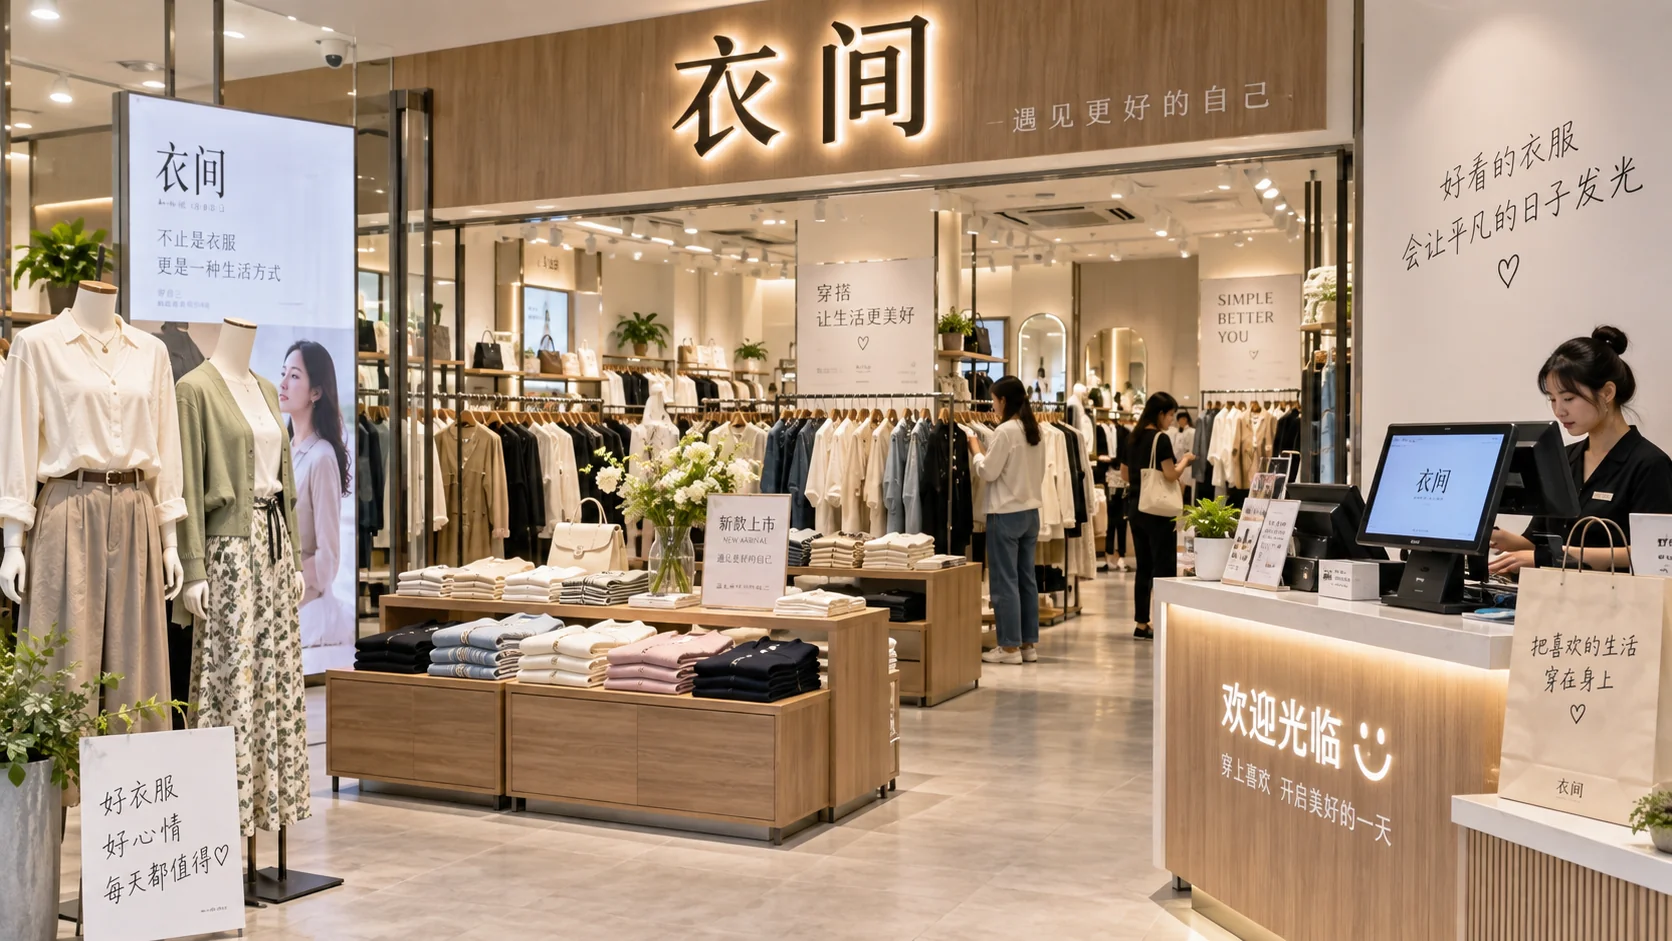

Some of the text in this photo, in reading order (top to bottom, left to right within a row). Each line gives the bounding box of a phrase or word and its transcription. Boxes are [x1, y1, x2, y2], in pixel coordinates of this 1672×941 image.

[673, 15, 931, 157] 衣间
[1012, 81, 1270, 133] 遇见更好的自己
[156, 141, 225, 199] 衣间
[1440, 120, 1579, 201] 好看的衣服
[1402, 156, 1644, 271] 会让平凡的日子发光
[157, 229, 236, 252] 不止是衣服
[157, 256, 281, 282] 更是一种生活方式
[817, 283, 851, 303] 穿搭
[1217, 291, 1274, 306] SIMPLE
[816, 306, 915, 327] 让生活更美好
[1218, 310, 1274, 325] BETTER
[1218, 330, 1249, 343] YOU
[1416, 468, 1451, 494] 衣间
[1531, 632, 1638, 658] 把喜欢的生活
[1544, 665, 1614, 693] 穿在身上
[1221, 682, 1342, 769] 欢迎光临
[99, 774, 179, 816] 好衣服
[1221, 753, 1392, 847] 穿上喜欢 开启美好的一天
[1556, 778, 1584, 798] 衣间
[102, 813, 182, 860] 好心情
[104, 846, 212, 904] 每天都值得
